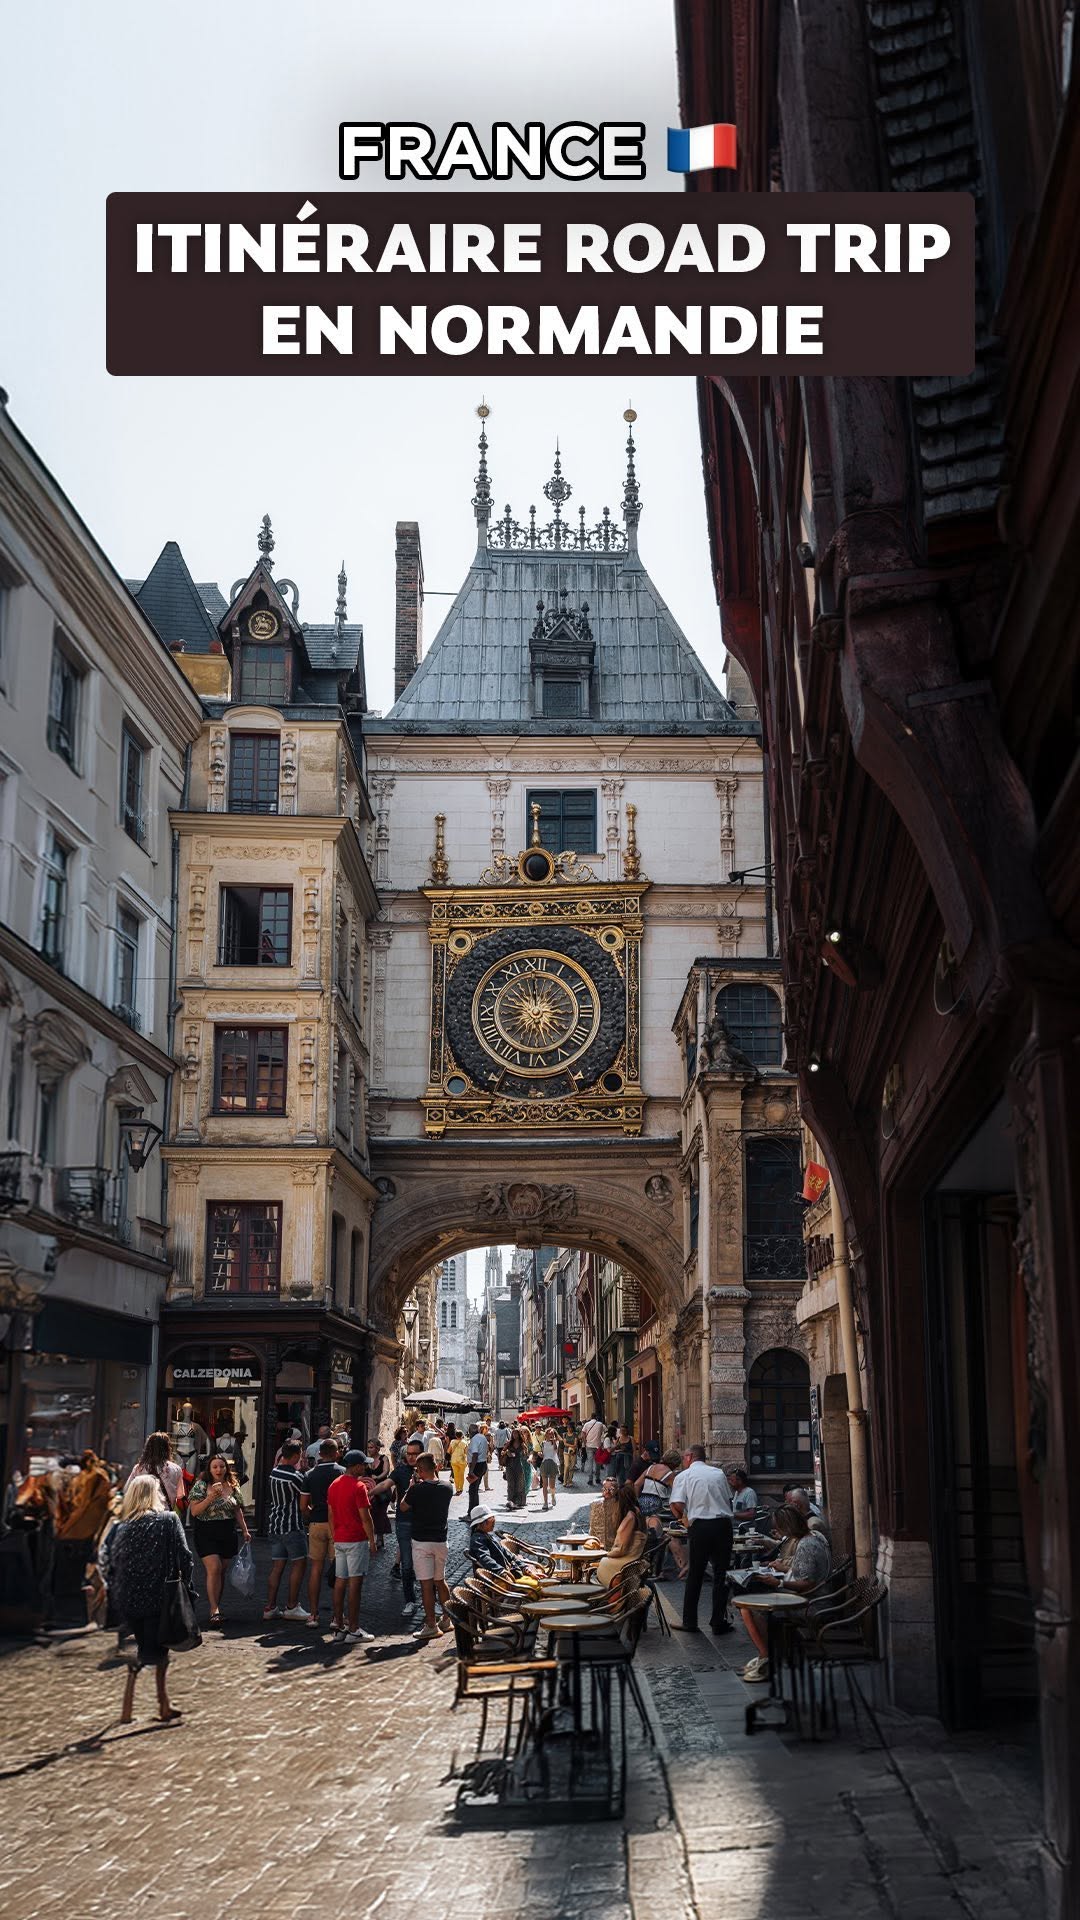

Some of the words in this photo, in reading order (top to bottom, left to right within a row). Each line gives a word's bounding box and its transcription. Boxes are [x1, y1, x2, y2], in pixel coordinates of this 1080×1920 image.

[501, 962, 521, 981] XI
[524, 958, 547, 971] XII
[485, 981, 501, 997] X
[571, 981, 586, 994] II
[579, 1004, 593, 1018] III
[500, 1044, 521, 1065] VII
[528, 1054, 547, 1067] VI
[558, 1047, 570, 1061] V
[173, 1368, 252, 1379] CALZEDONIA
